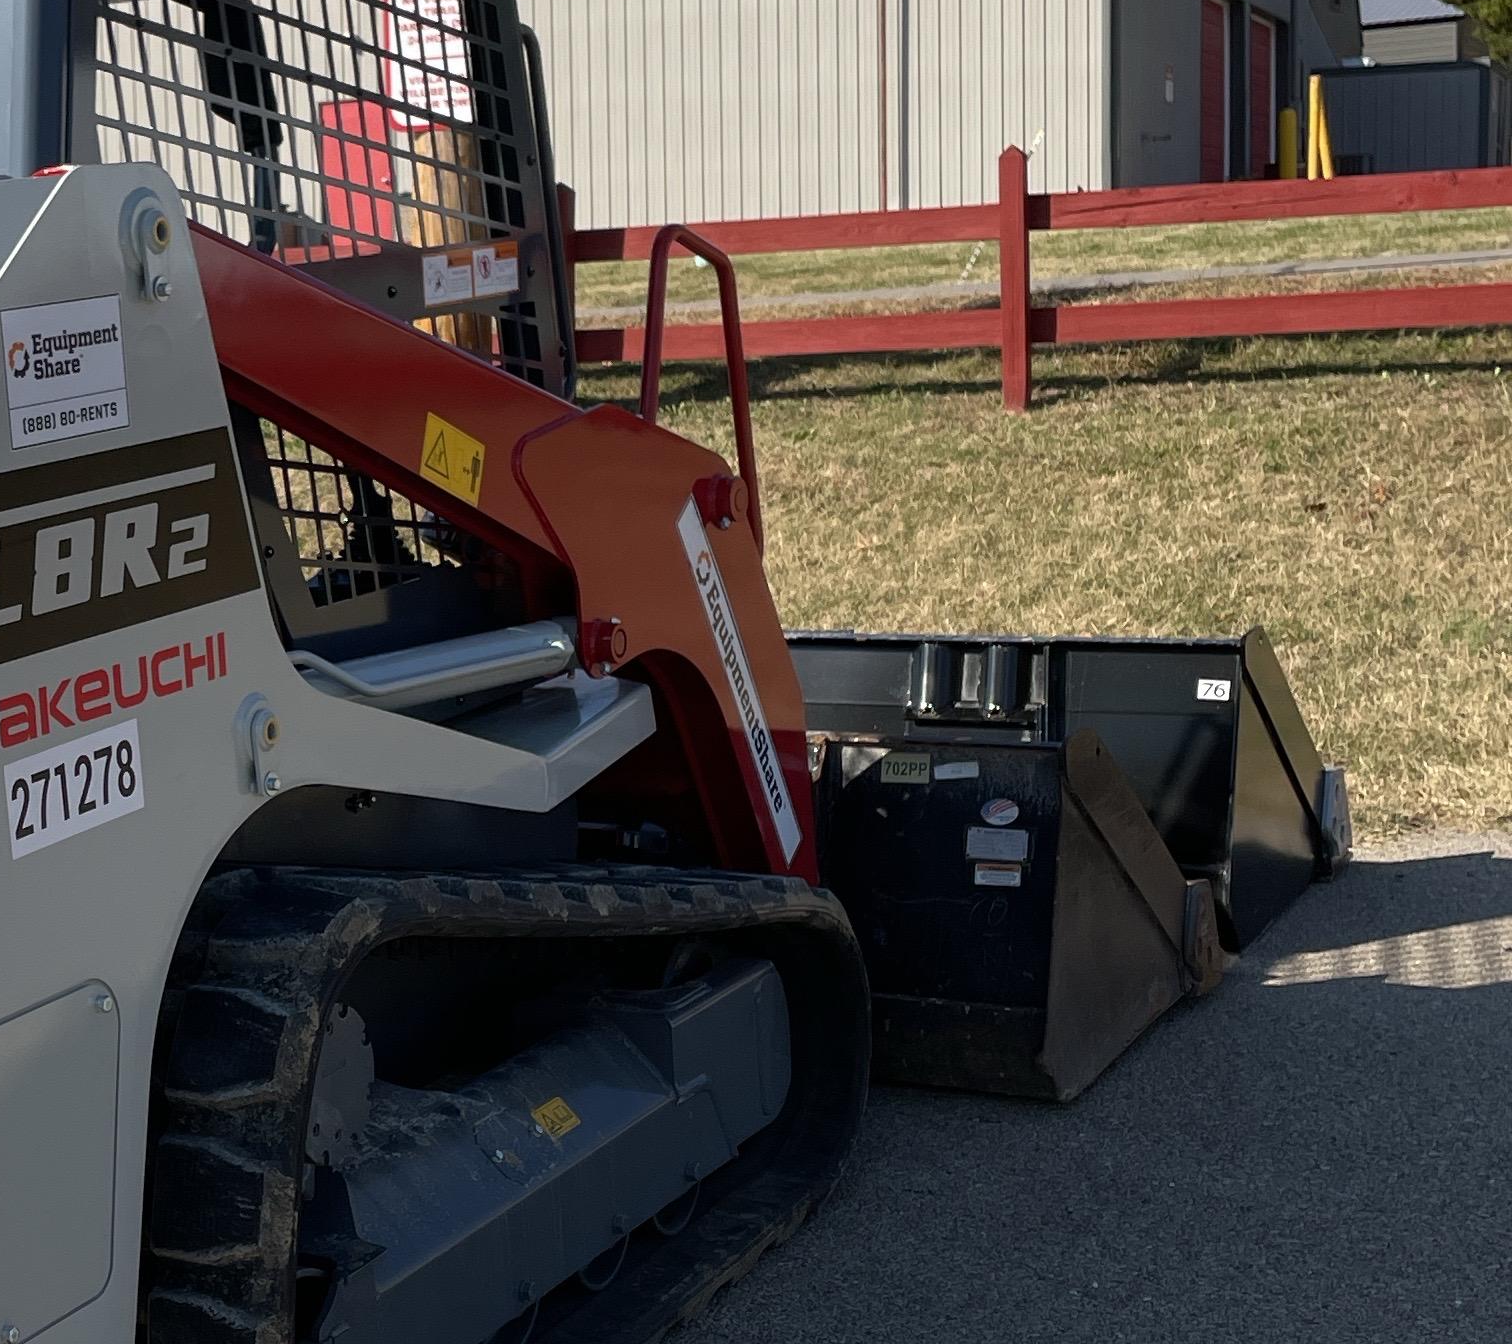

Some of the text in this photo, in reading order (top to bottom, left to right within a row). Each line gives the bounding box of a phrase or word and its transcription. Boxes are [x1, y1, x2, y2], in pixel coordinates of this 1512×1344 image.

[31, 323, 119, 358] Equipment
[33, 357, 82, 380] Share
[22, 402, 118, 435] (888) 80-RENTS
[705, 582, 784, 814] EquipmentShare
[1202, 682, 1226, 698] 76
[883, 760, 928, 777] 702PP
[11, 739, 137, 841] 271278
